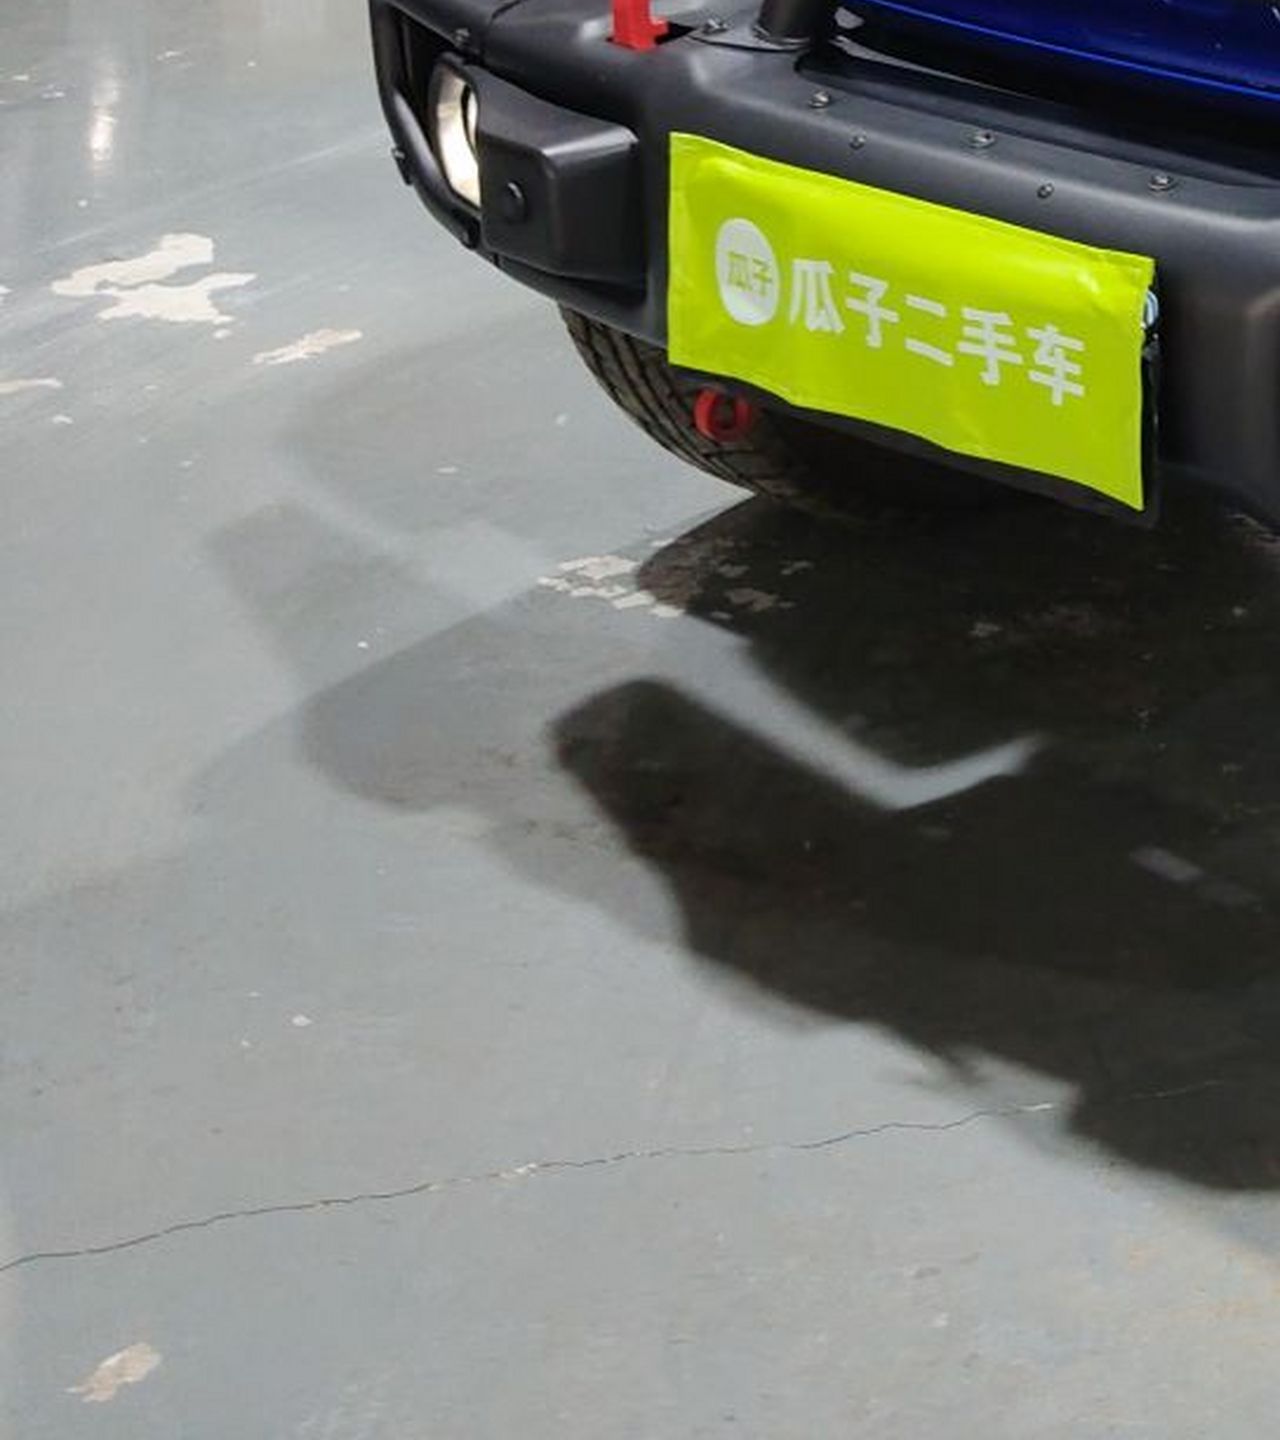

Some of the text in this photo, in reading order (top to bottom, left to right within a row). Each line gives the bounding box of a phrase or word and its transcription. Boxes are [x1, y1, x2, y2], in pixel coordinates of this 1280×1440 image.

[726, 251, 774, 298] 瓜子
[789, 259, 1085, 407] 瓜子二手车
